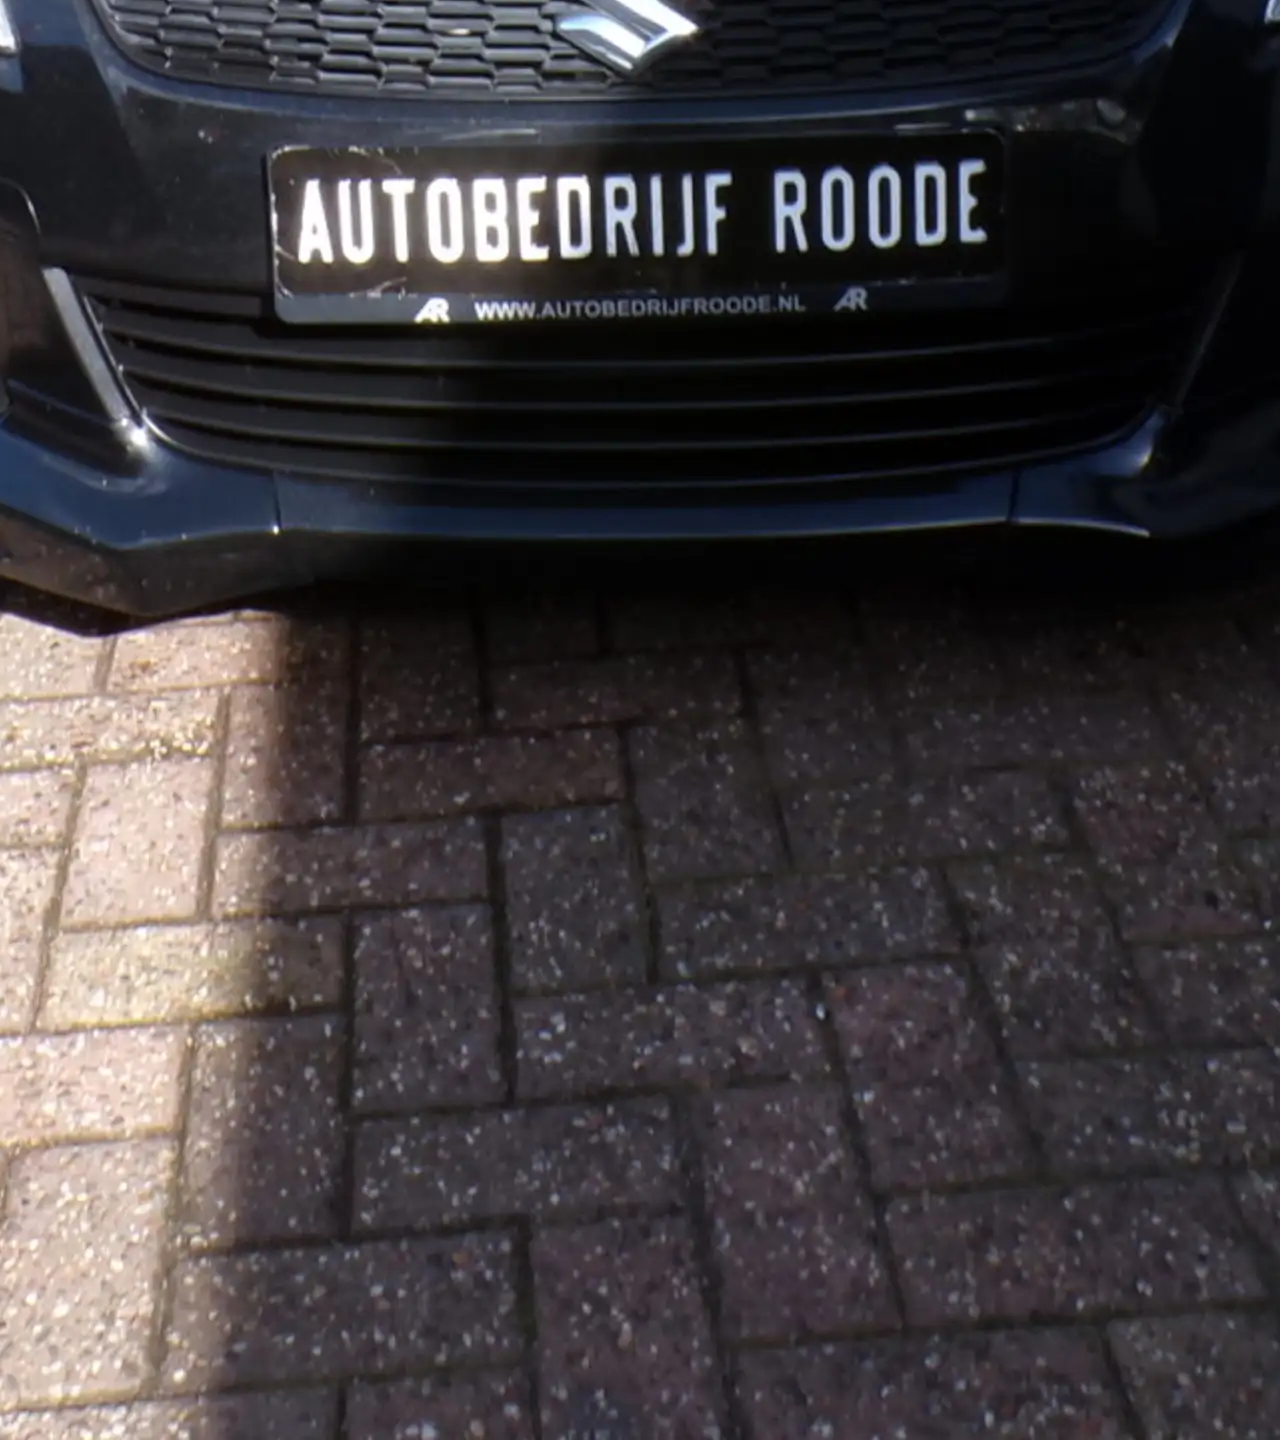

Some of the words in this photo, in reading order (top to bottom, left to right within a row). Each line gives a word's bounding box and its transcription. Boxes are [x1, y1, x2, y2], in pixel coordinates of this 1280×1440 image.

[297, 172, 734, 265] AUTOBEDRIJF
[773, 159, 988, 254] ROODE
[473, 294, 806, 322] WWW.AUTOBEDRIJFROODE.NL
